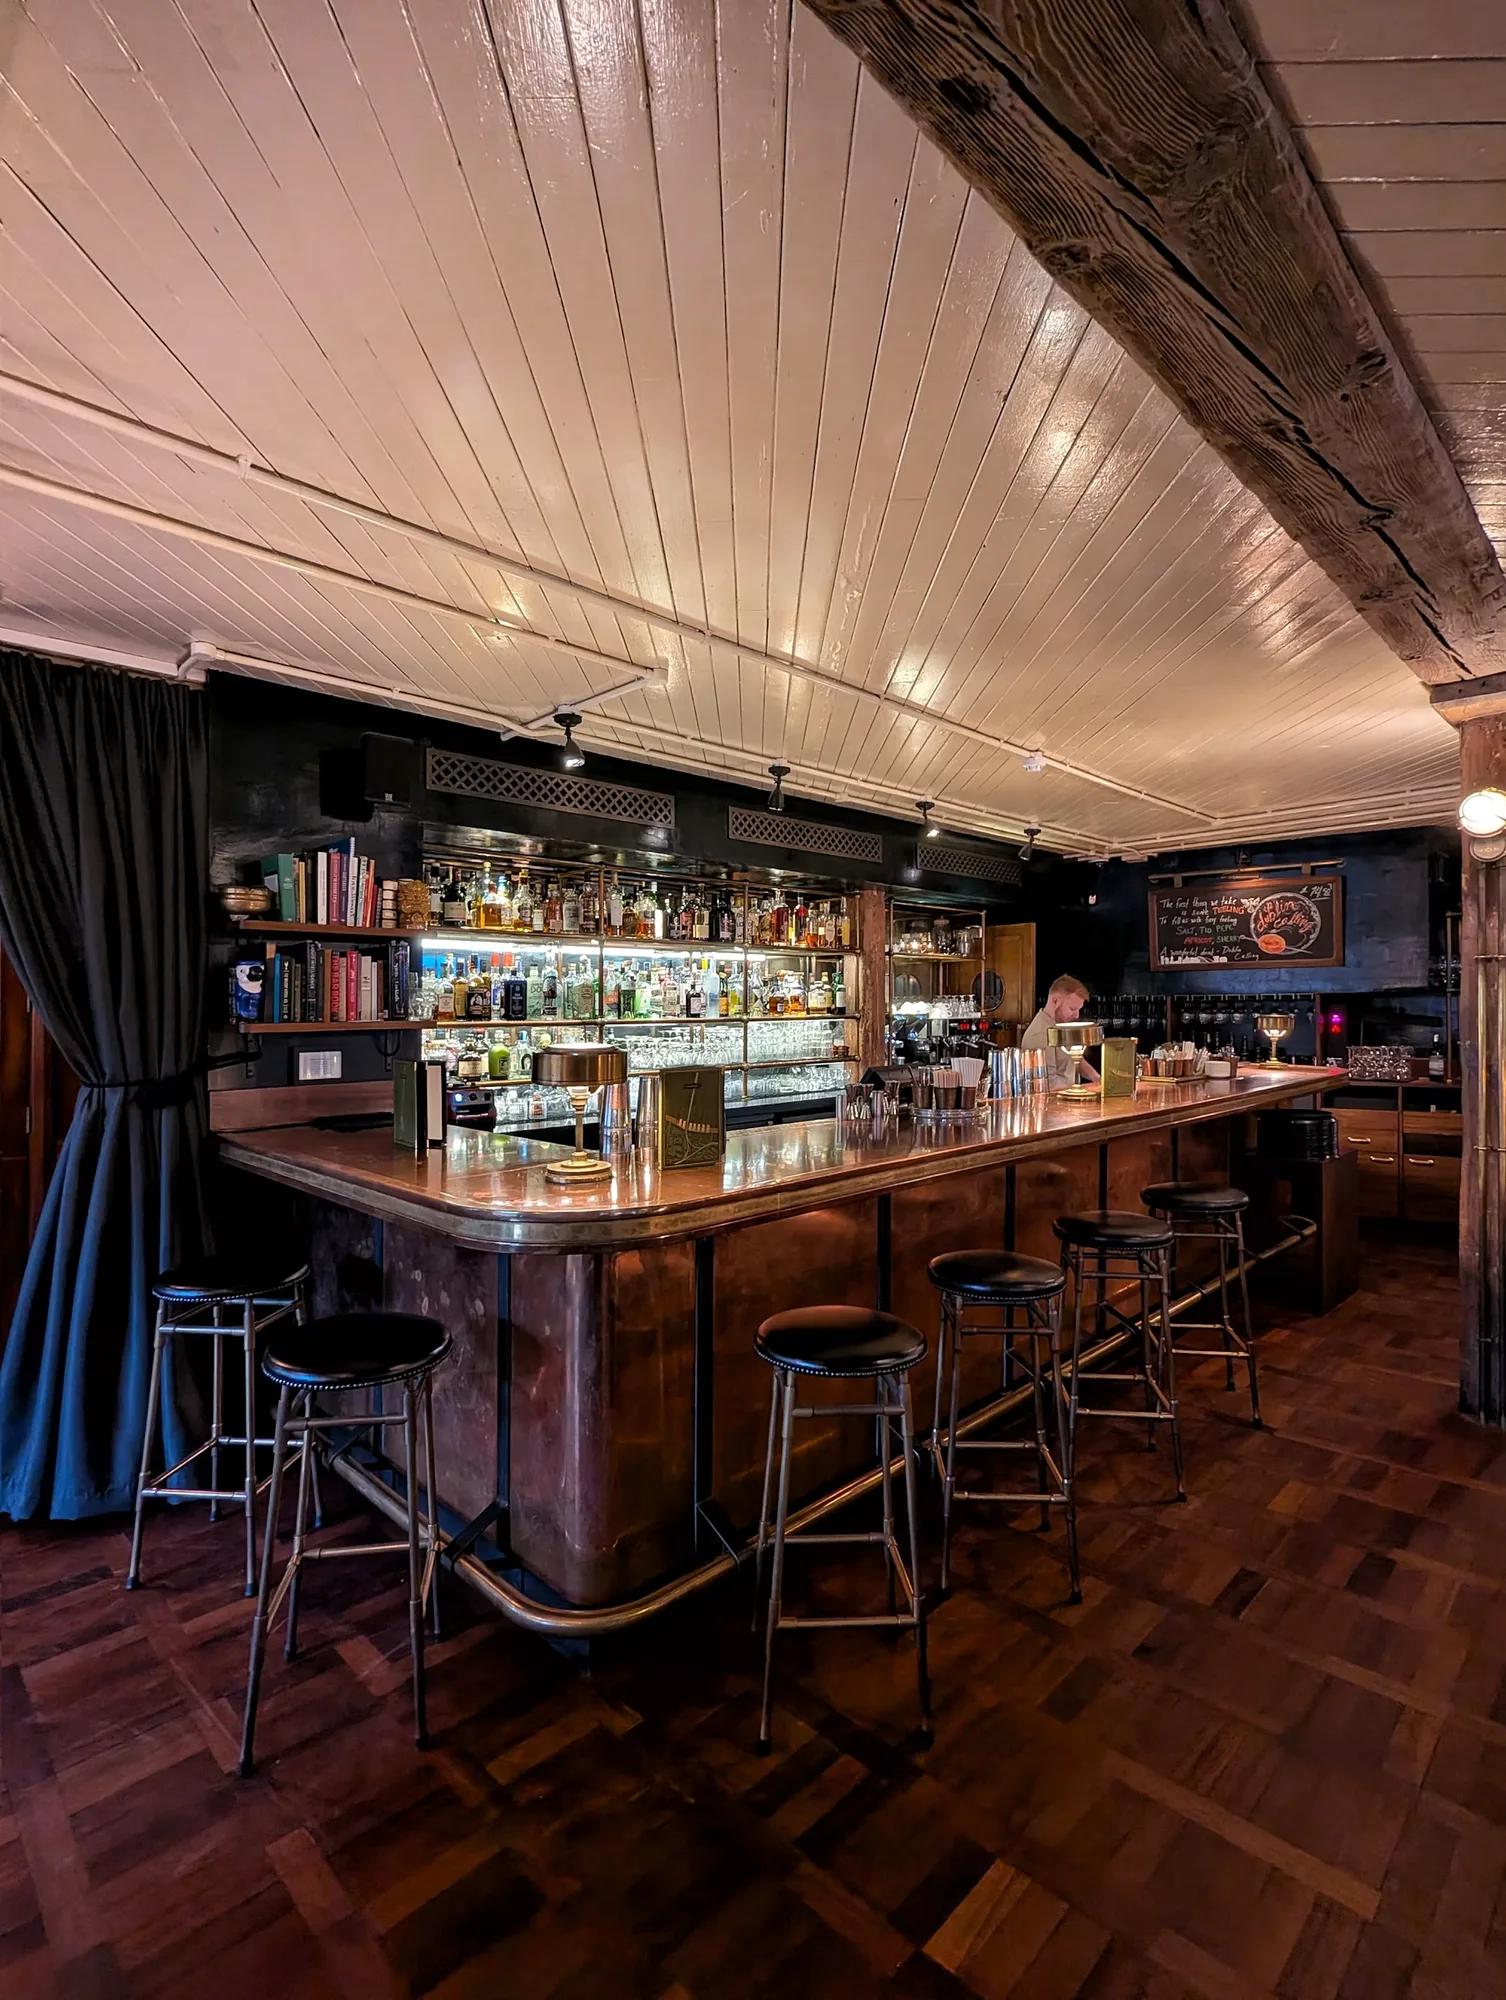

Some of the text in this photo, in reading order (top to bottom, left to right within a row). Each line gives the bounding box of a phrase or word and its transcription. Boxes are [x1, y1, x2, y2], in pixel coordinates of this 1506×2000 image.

[1160, 898, 1173, 909] The
[1220, 896, 1237, 906] take
[1199, 926, 1213, 934] TIO
[1216, 935, 1241, 943] SHERRY
[1159, 946, 1168, 957] A
[331, 972, 339, 990] BAR
[331, 990, 339, 1013] BOOK
